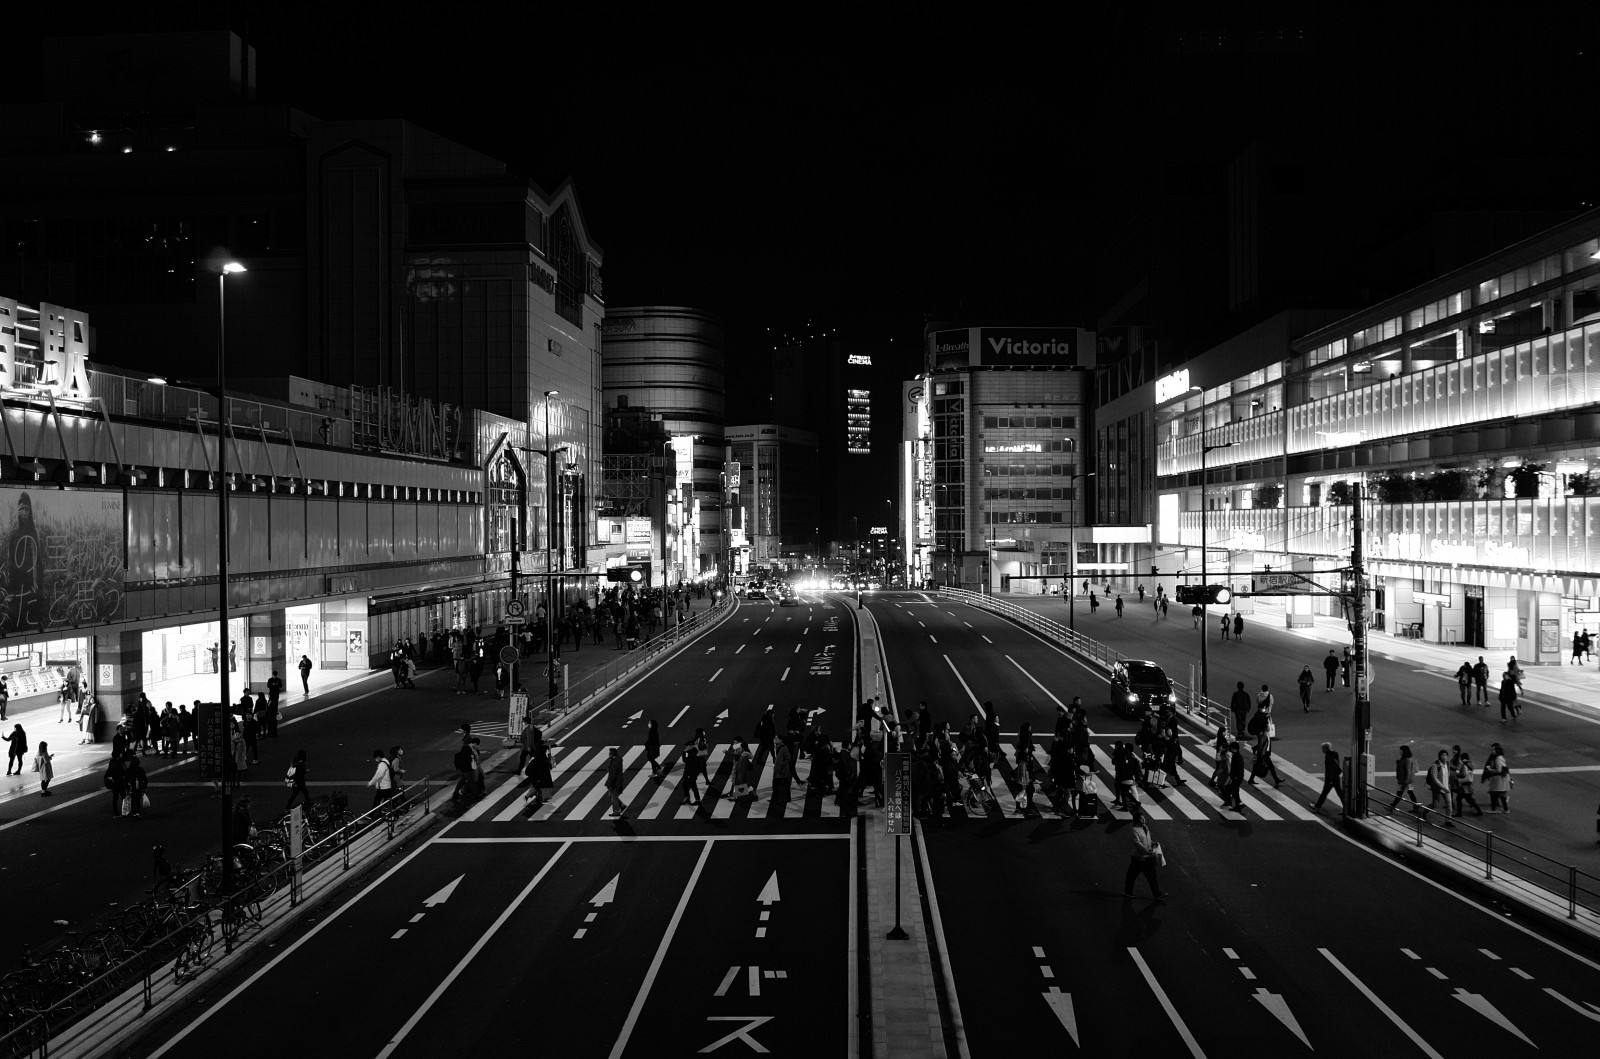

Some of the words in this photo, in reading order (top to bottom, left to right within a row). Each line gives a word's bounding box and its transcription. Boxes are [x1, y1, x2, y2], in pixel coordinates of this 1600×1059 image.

[936, 341, 969, 353] L-Breath
[988, 336, 1069, 355] Victoria
[847, 359, 872, 368] CINEMA
[949, 400, 960, 458] Victoria
[887, 797, 895, 833] 入れません
[696, 966, 788, 1053] バス
